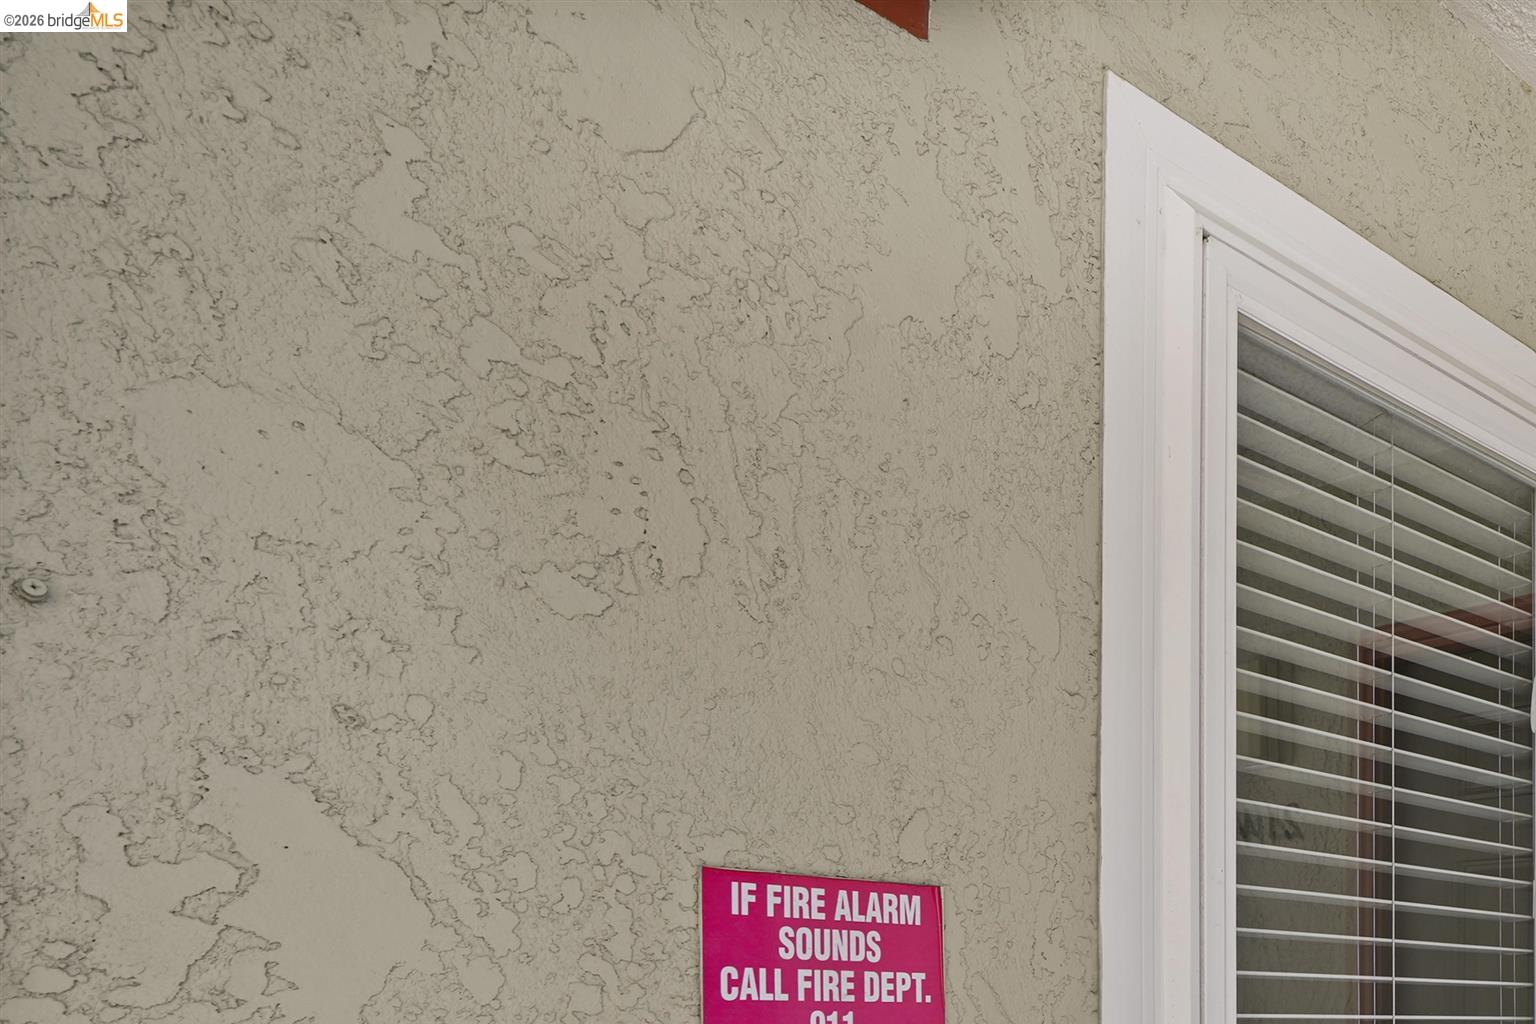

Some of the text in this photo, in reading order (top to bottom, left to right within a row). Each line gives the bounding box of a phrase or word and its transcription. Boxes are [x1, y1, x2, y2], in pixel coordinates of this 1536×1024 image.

[730, 881, 921, 926] IF FIRE ALARM
[778, 926, 881, 962] SOUNDS
[719, 966, 932, 1003] CALL FIRE DEPT.
